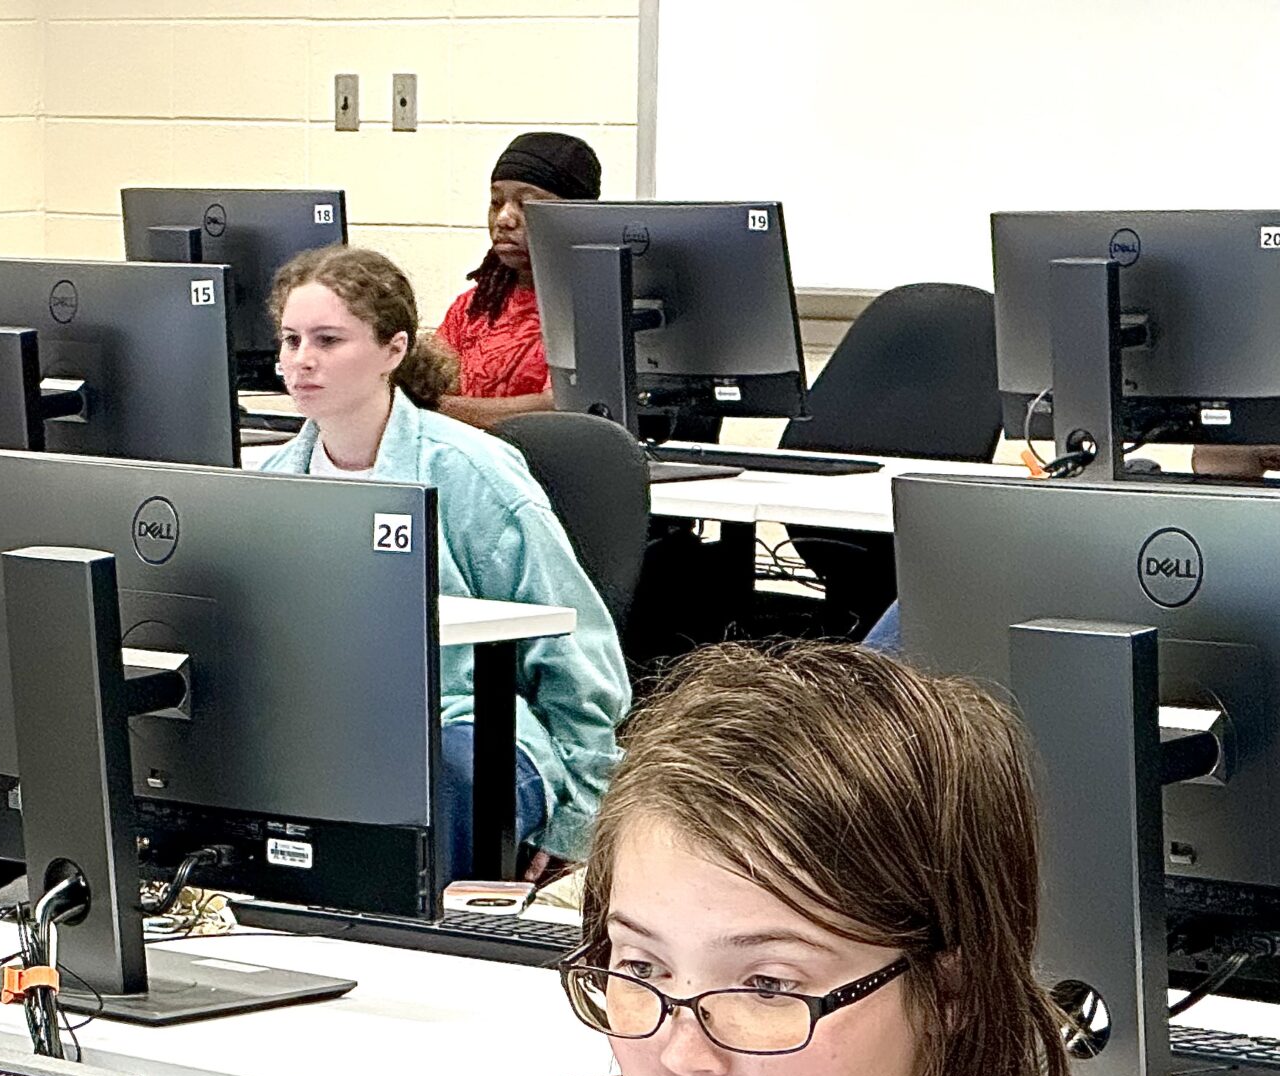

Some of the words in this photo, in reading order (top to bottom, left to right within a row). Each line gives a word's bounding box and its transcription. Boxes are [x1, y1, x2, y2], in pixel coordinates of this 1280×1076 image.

[317, 210, 331, 222] 18
[751, 214, 766, 228] 19
[1263, 233, 1280, 246] 20
[194, 287, 211, 303] 15
[138, 521, 174, 540] DELL
[377, 523, 410, 549] 26
[1145, 557, 1197, 579] DELL
